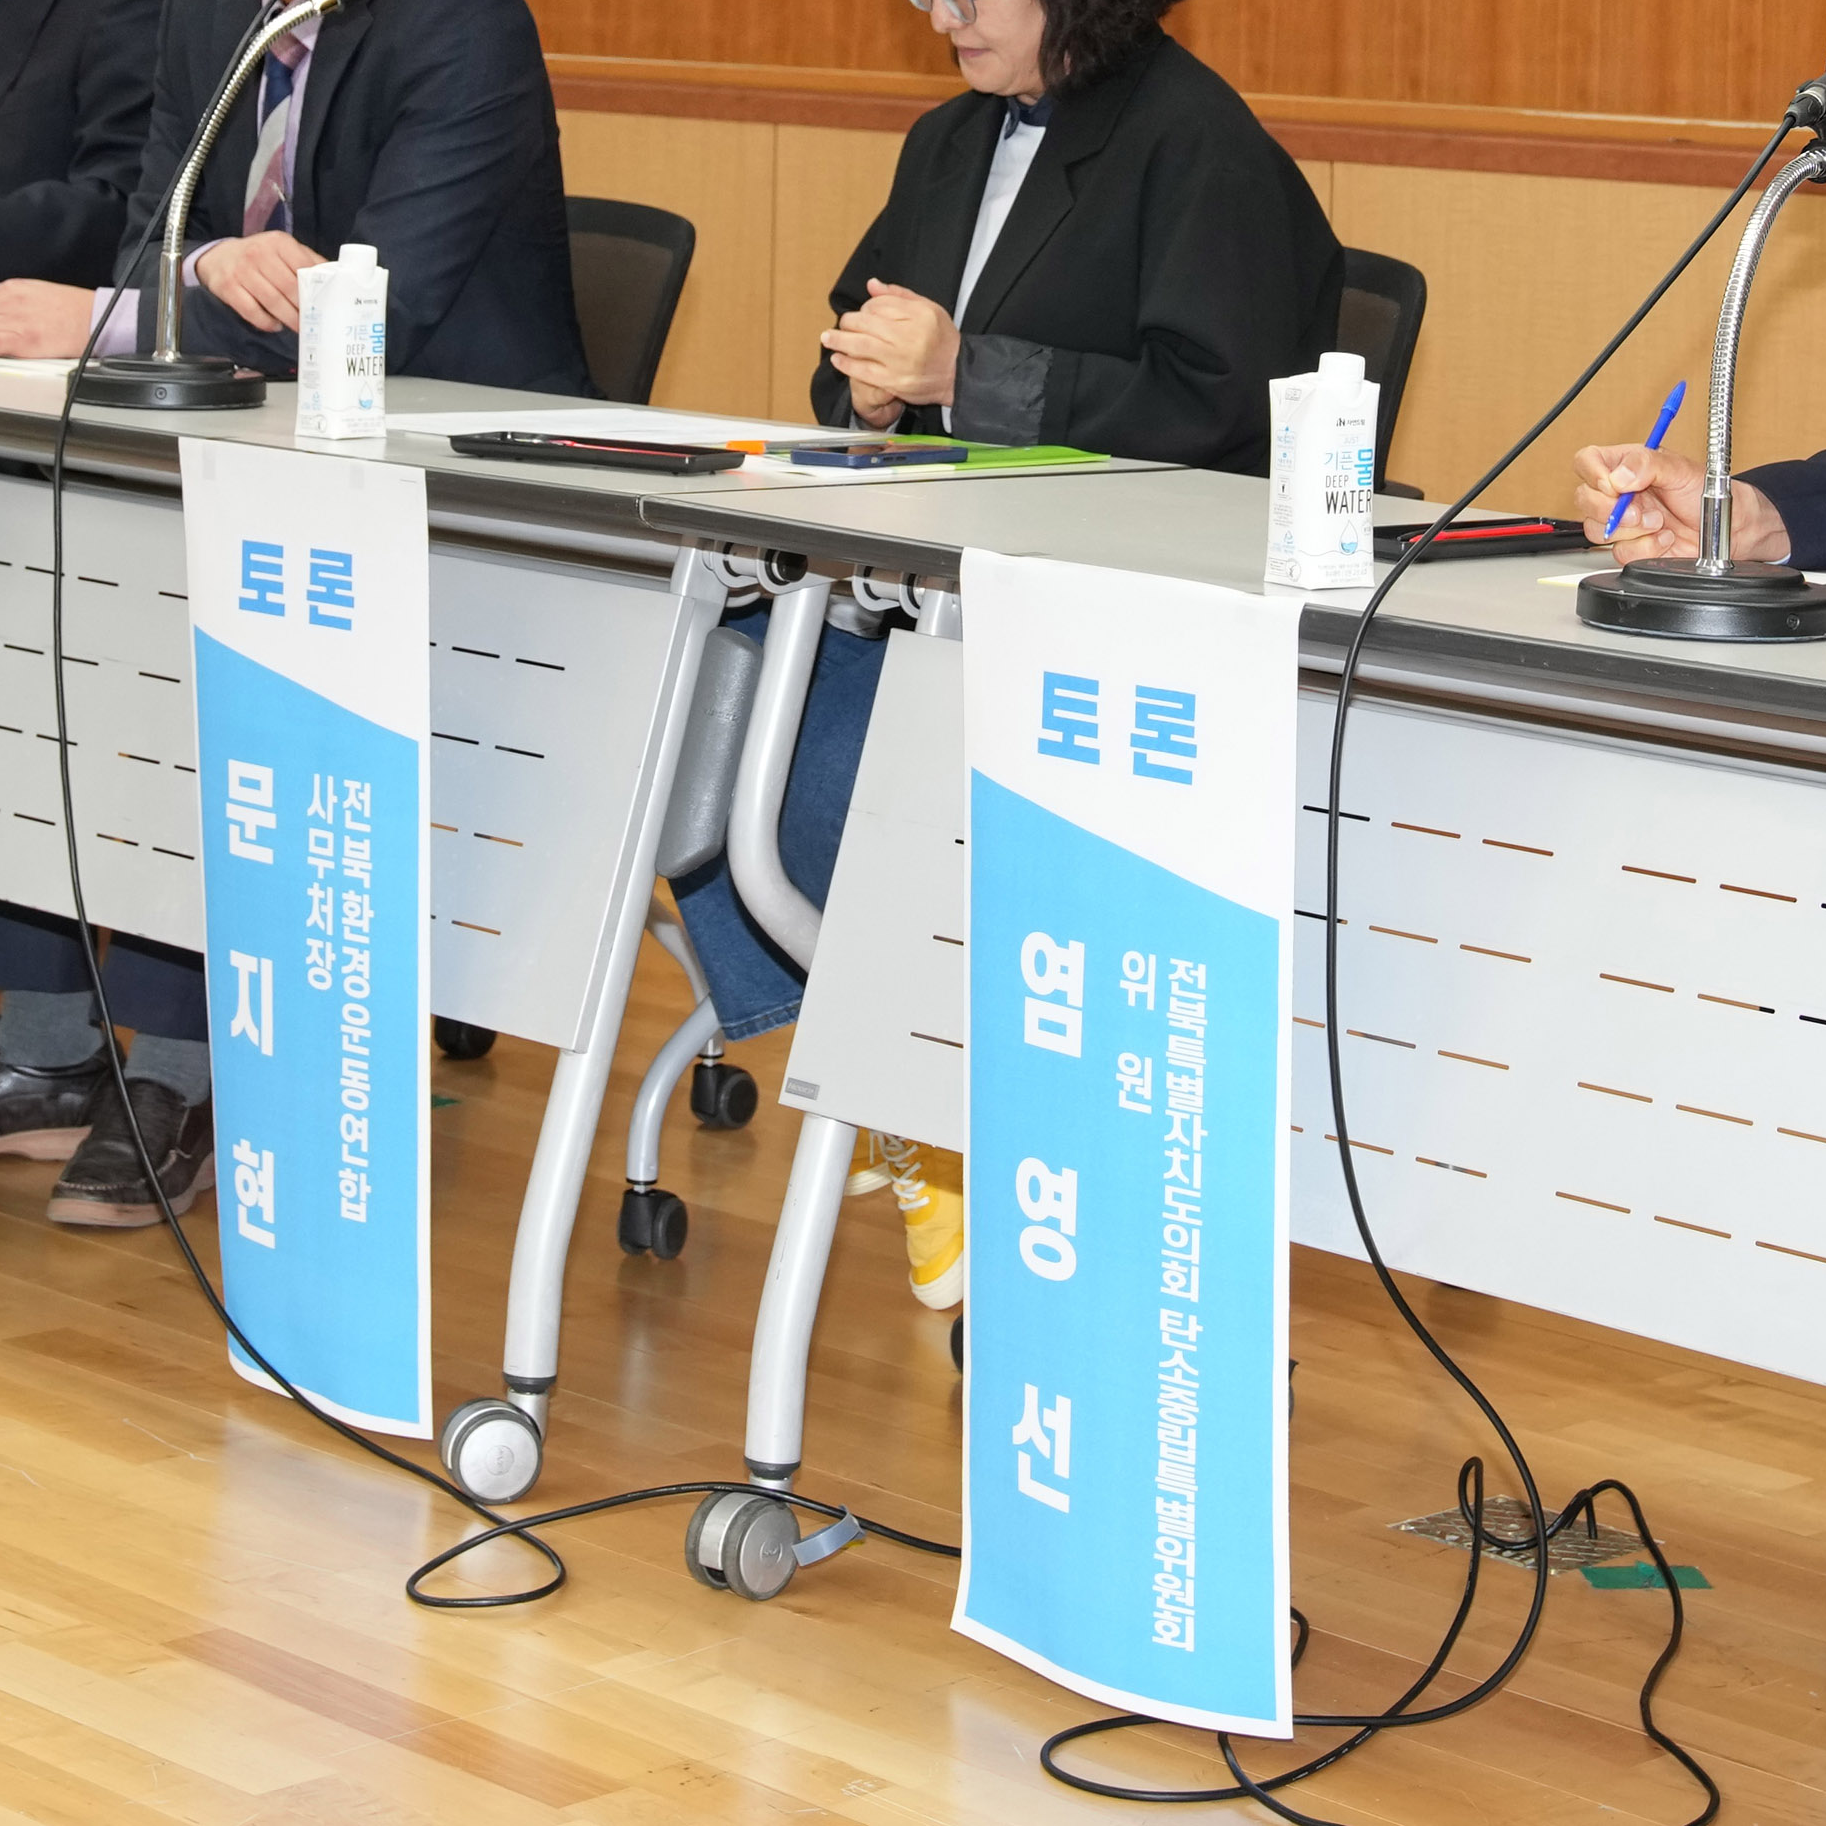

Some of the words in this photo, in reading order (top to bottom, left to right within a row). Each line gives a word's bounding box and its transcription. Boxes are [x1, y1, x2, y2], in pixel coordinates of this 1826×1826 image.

[346, 344, 365, 355] DEEP
[346, 356, 384, 376] WATER
[1326, 474, 1349, 488] DEEP
[1326, 489, 1372, 514] WATER
[1354, 448, 1374, 486] 물
[238, 540, 355, 630] 토론
[1037, 671, 1198, 785] 토론
[304, 773, 339, 992] 사무처장
[226, 760, 277, 1249] 문지현
[338, 778, 375, 1224] 전북환경운동연합
[1115, 949, 1157, 1116] 위원
[1159, 955, 1208, 1304] 전북특별자치도의회
[1012, 932, 1085, 1513] 염영선
[1151, 1307, 1204, 1653] 탄소중립특별위원회
